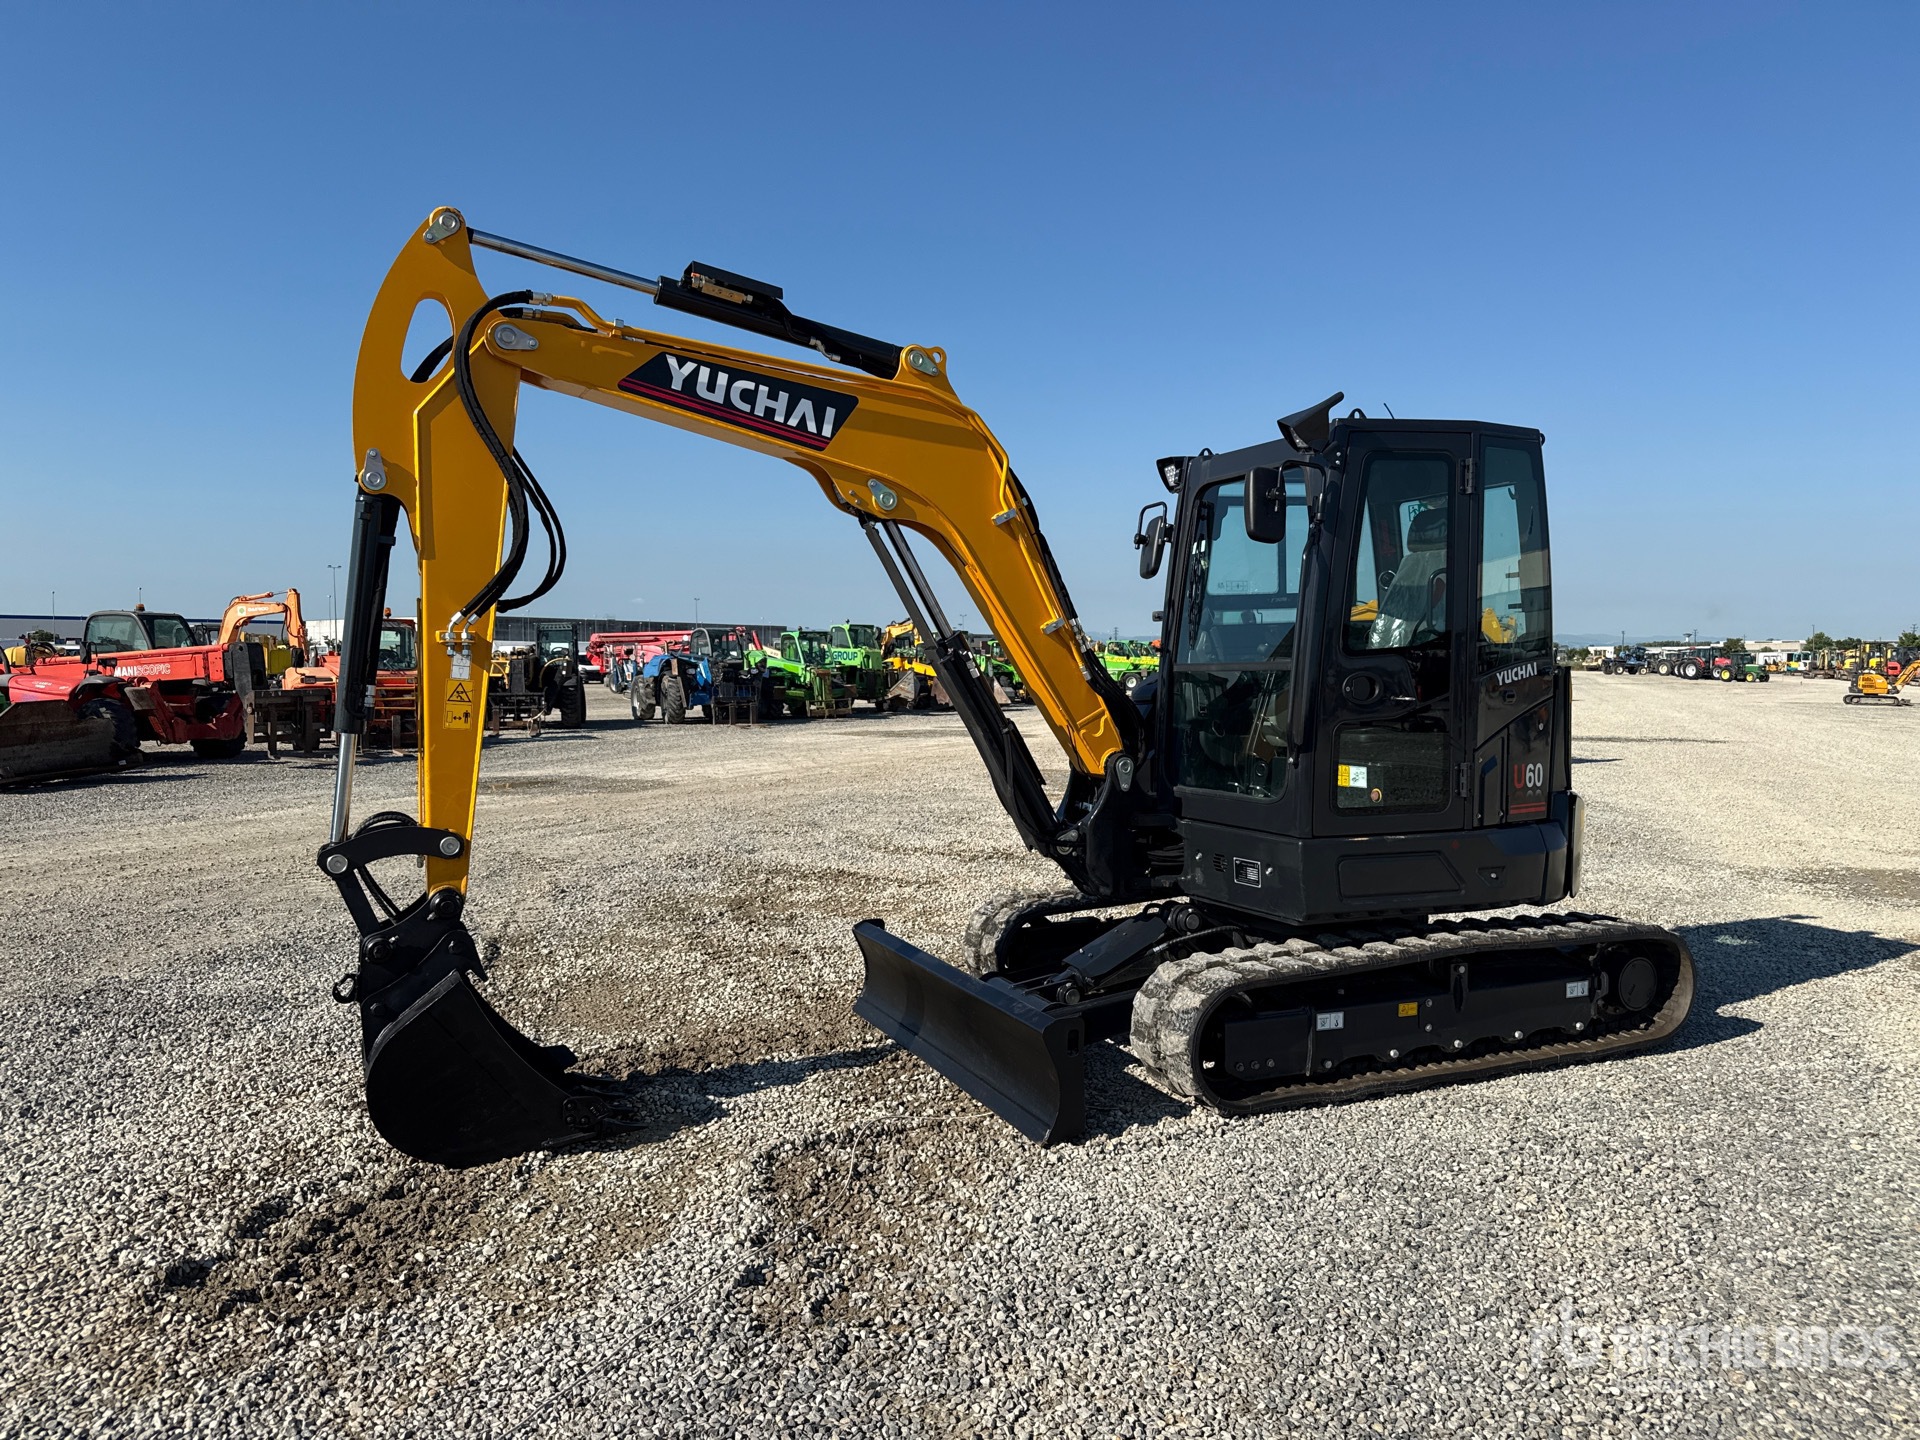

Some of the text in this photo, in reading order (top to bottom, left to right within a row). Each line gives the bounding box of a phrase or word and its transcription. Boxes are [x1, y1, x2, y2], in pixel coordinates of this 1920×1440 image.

[665, 353, 837, 439] YUCHAI
[832, 650, 858, 661] GROUP
[113, 663, 171, 677] MANISCOPIC
[1496, 661, 1538, 686] YUCHAI
[1513, 762, 1544, 789] U60
